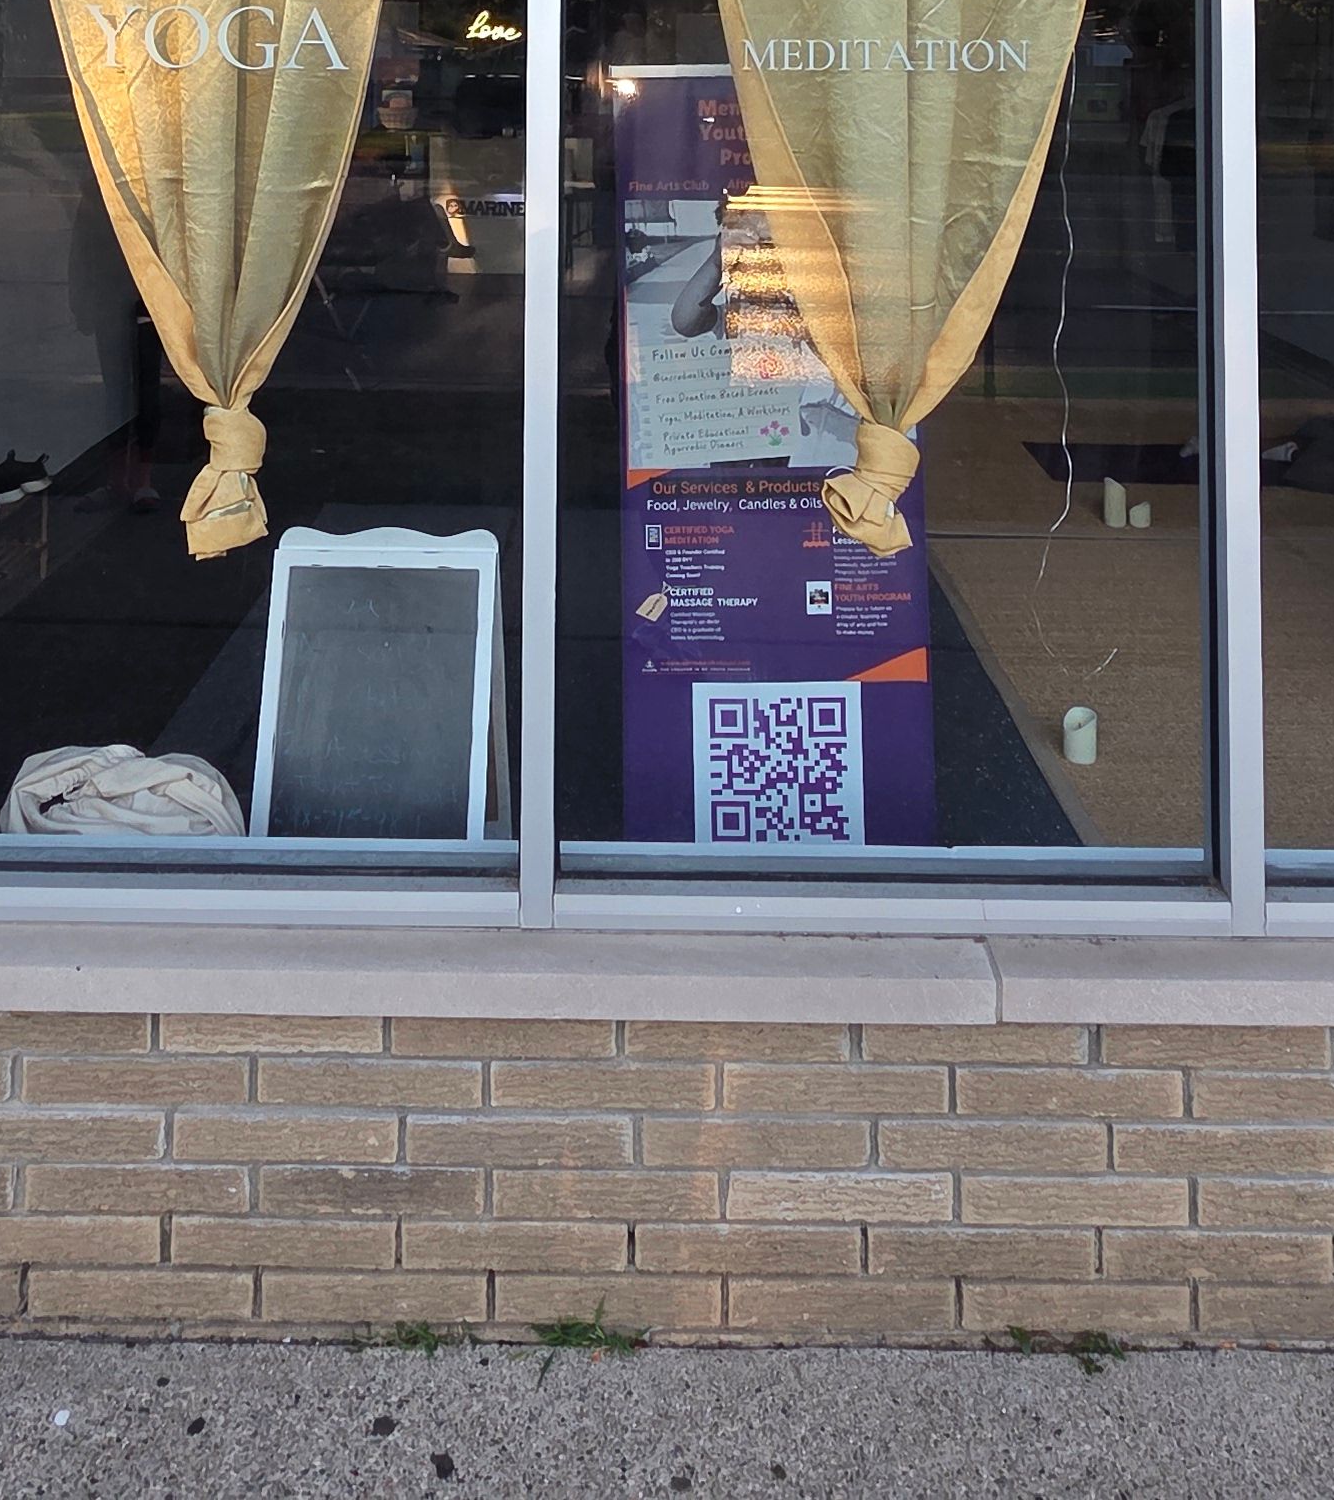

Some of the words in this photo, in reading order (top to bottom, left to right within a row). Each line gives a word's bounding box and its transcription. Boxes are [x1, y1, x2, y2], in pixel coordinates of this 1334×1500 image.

[85, 4, 350, 72] YOGA
[741, 38, 1030, 73] MEDITATION
[629, 181, 653, 191] Fine
[656, 181, 680, 191] Arts
[683, 180, 709, 191] Club
[459, 200, 526, 216] MARINE
[652, 349, 686, 362] Follow
[691, 347, 705, 358] Us
[719, 388, 744, 398] Based
[747, 406, 791, 417] Workshops
[698, 427, 750, 439] Educational
[710, 440, 744, 450] Dinners
[652, 482, 677, 495] Our
[681, 482, 738, 494] Services
[746, 482, 755, 493] &
[759, 480, 820, 493] Products
[646, 499, 680, 512] Food,
[683, 499, 733, 513] Jewelry,
[738, 499, 786, 510] Candles
[789, 499, 797, 509] &
[800, 498, 823, 509] Oils
[664, 526, 708, 535] CERTIFIED
[710, 526, 735, 534] YOGA
[664, 536, 719, 545] MEDITATION
[670, 587, 714, 596] CERTIFIED
[856, 583, 879, 591] ARTS
[670, 598, 713, 607] MASSAGE
[717, 597, 759, 607] THERAPY
[835, 593, 865, 602] YOUTH
[867, 592, 912, 601] PROGRAM
